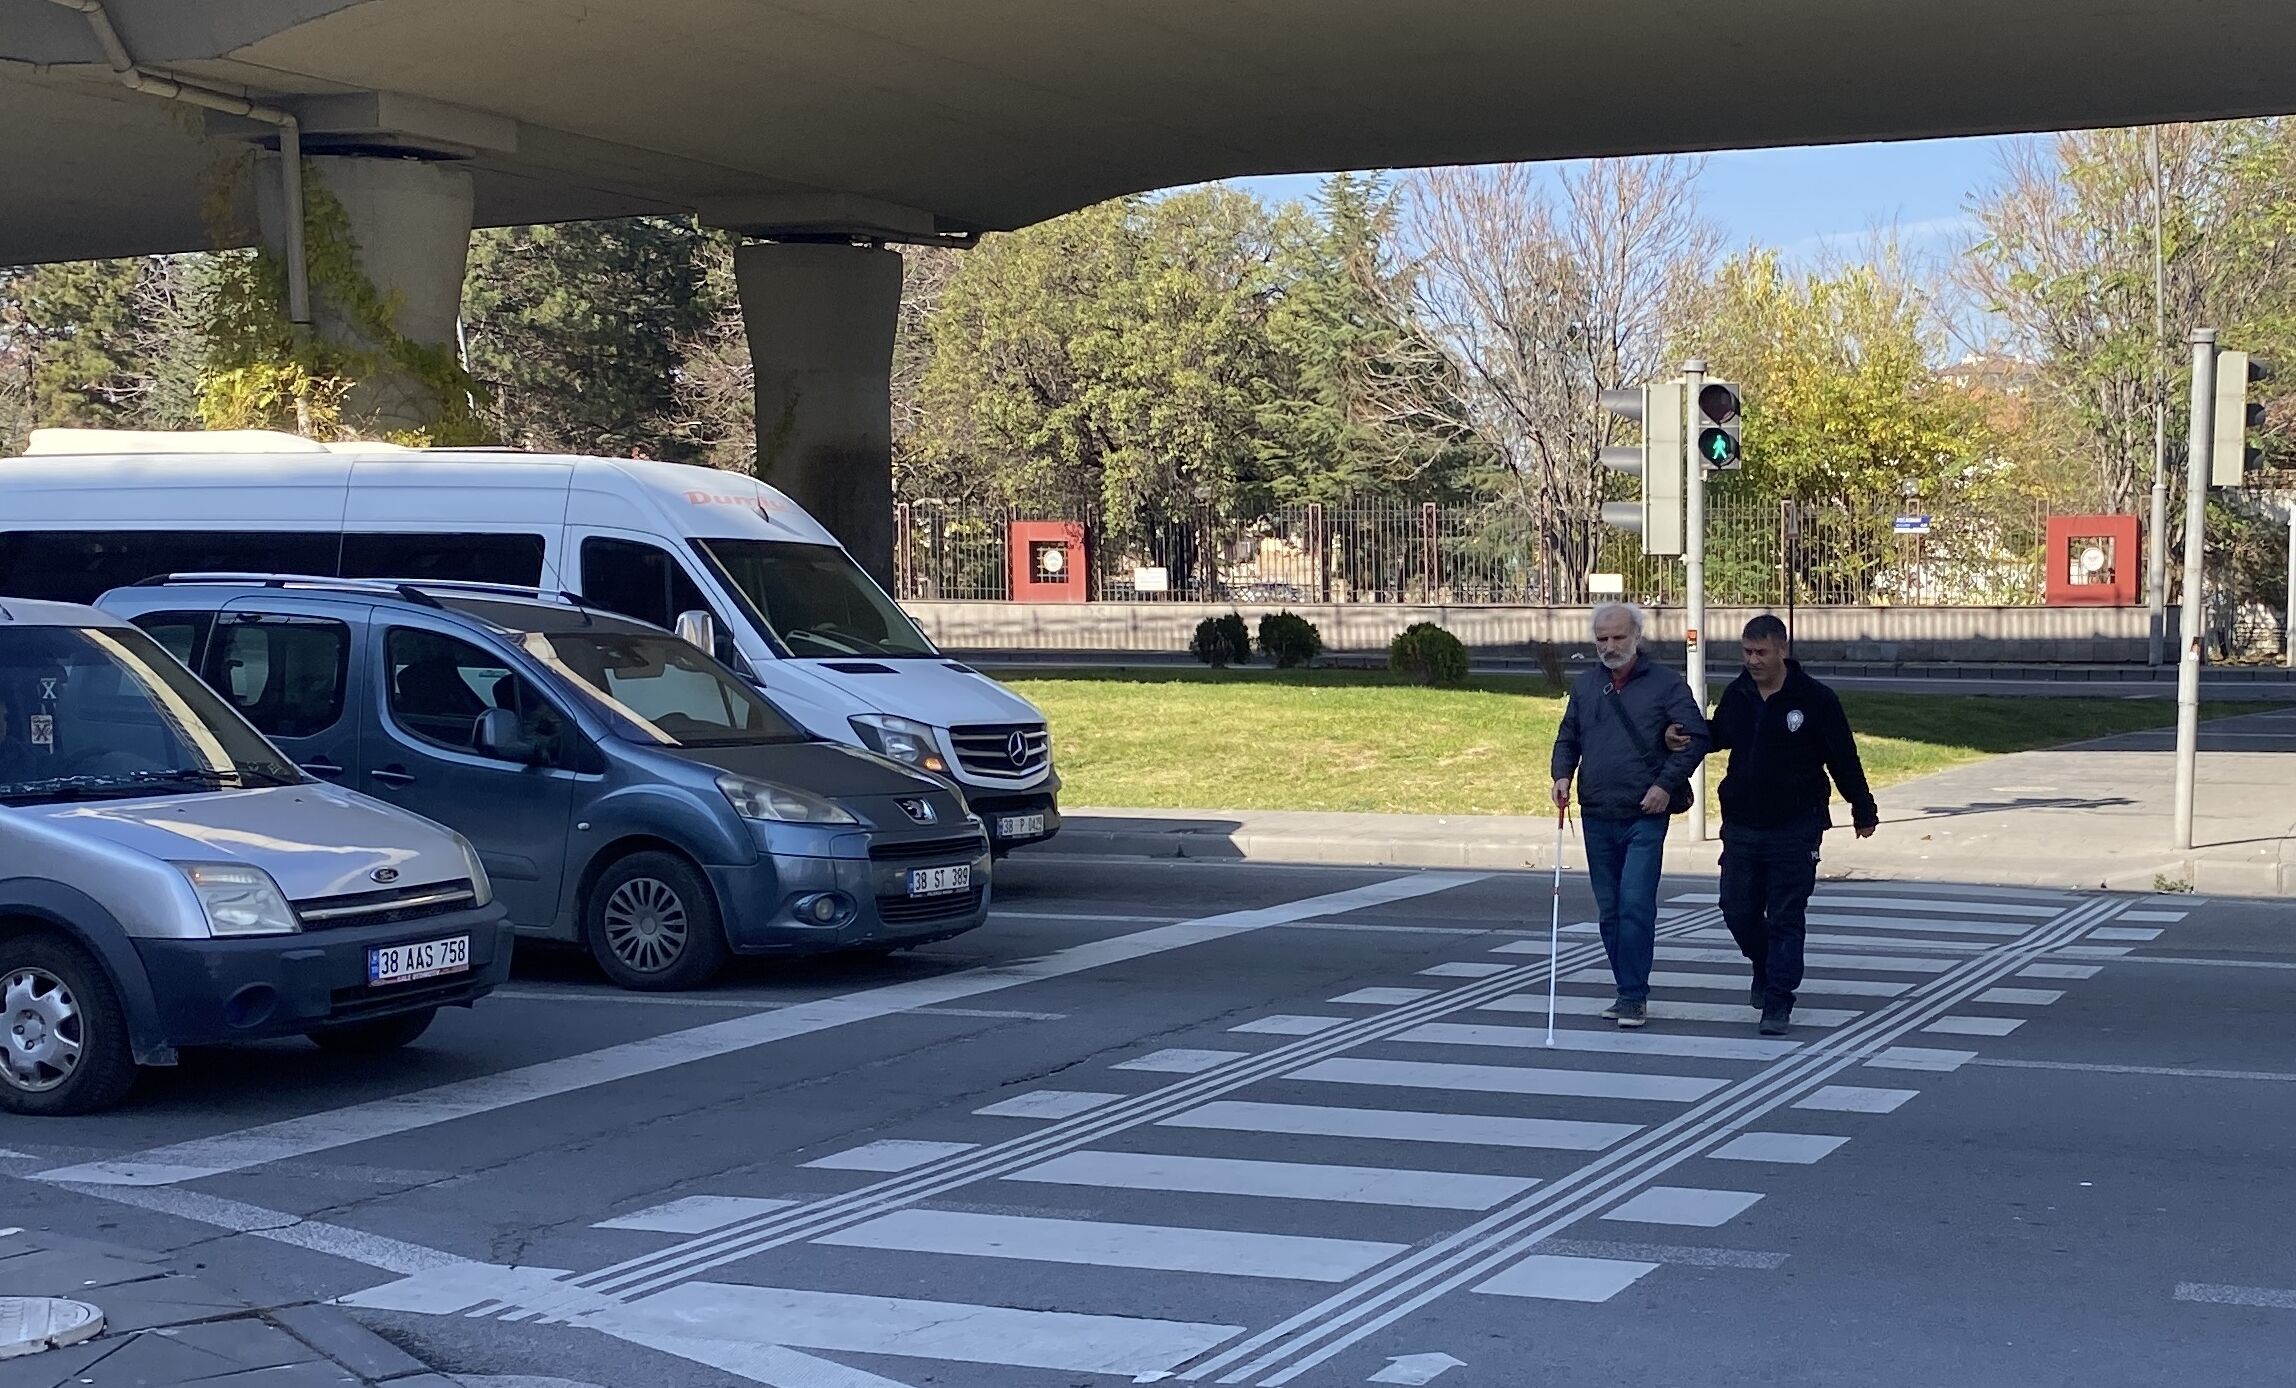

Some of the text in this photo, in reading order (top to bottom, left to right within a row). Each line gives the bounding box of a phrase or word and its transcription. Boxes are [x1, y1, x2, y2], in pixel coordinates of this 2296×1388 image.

[1003, 819, 1013, 834] 38
[915, 867, 968, 890] 38 ST 389
[381, 940, 465, 974] 38 AAS 758
